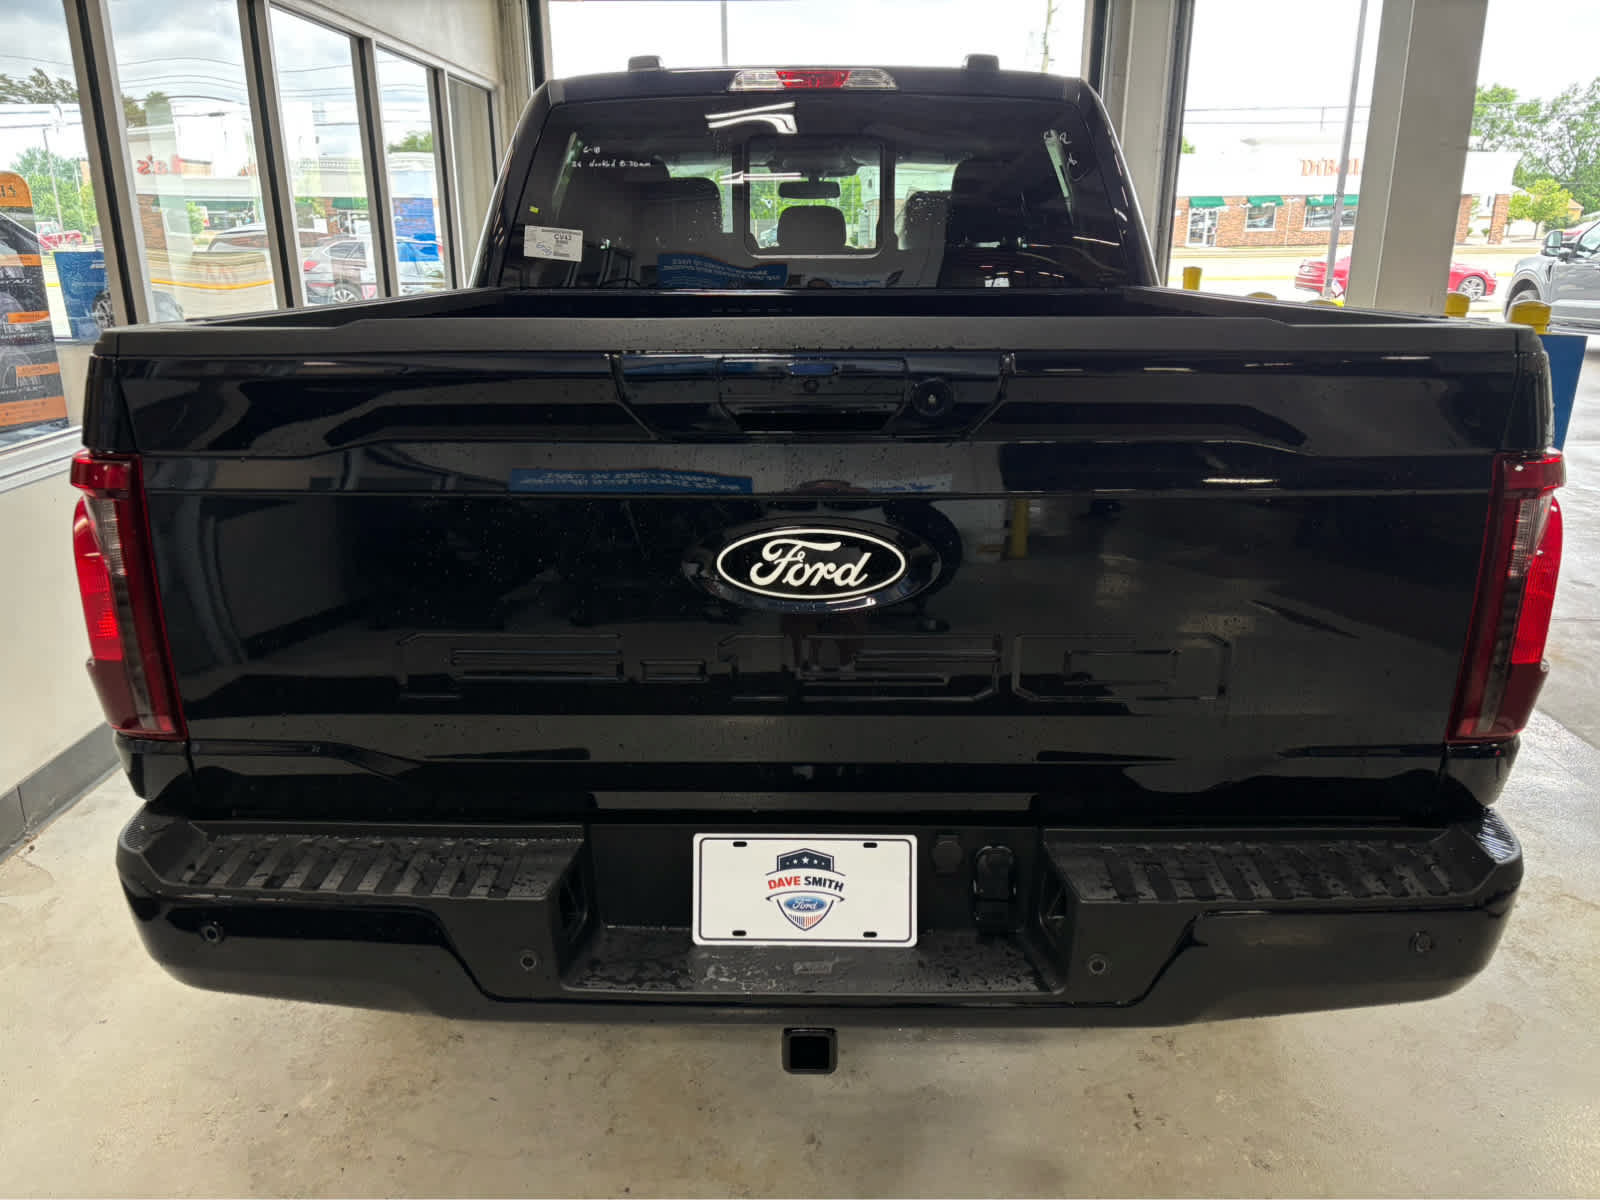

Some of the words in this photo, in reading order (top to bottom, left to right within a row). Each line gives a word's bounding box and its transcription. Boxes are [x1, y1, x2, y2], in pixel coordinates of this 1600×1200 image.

[750, 538, 872, 587] Ford
[767, 876, 801, 890] DAVE
[804, 876, 844, 892] SMITH
